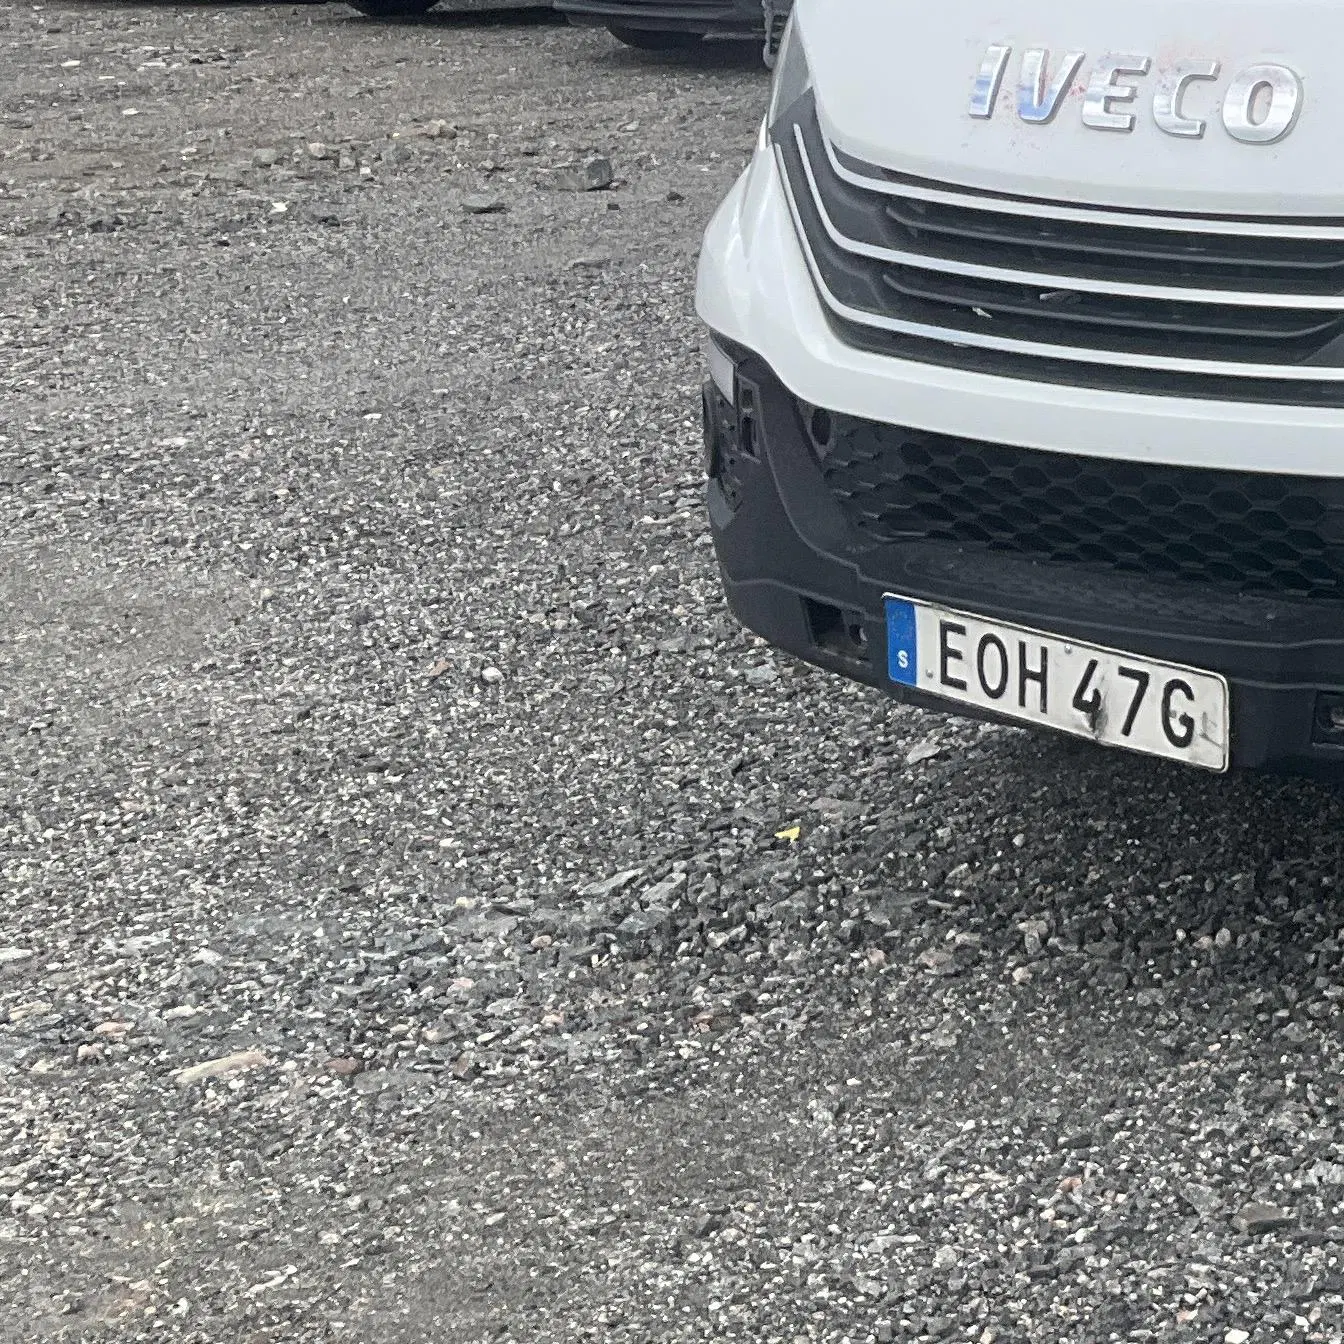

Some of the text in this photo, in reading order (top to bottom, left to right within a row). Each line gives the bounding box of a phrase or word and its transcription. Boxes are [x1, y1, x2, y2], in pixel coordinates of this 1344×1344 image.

[967, 42, 1305, 146] IVECO
[896, 618, 1196, 748] S EOH 47G
